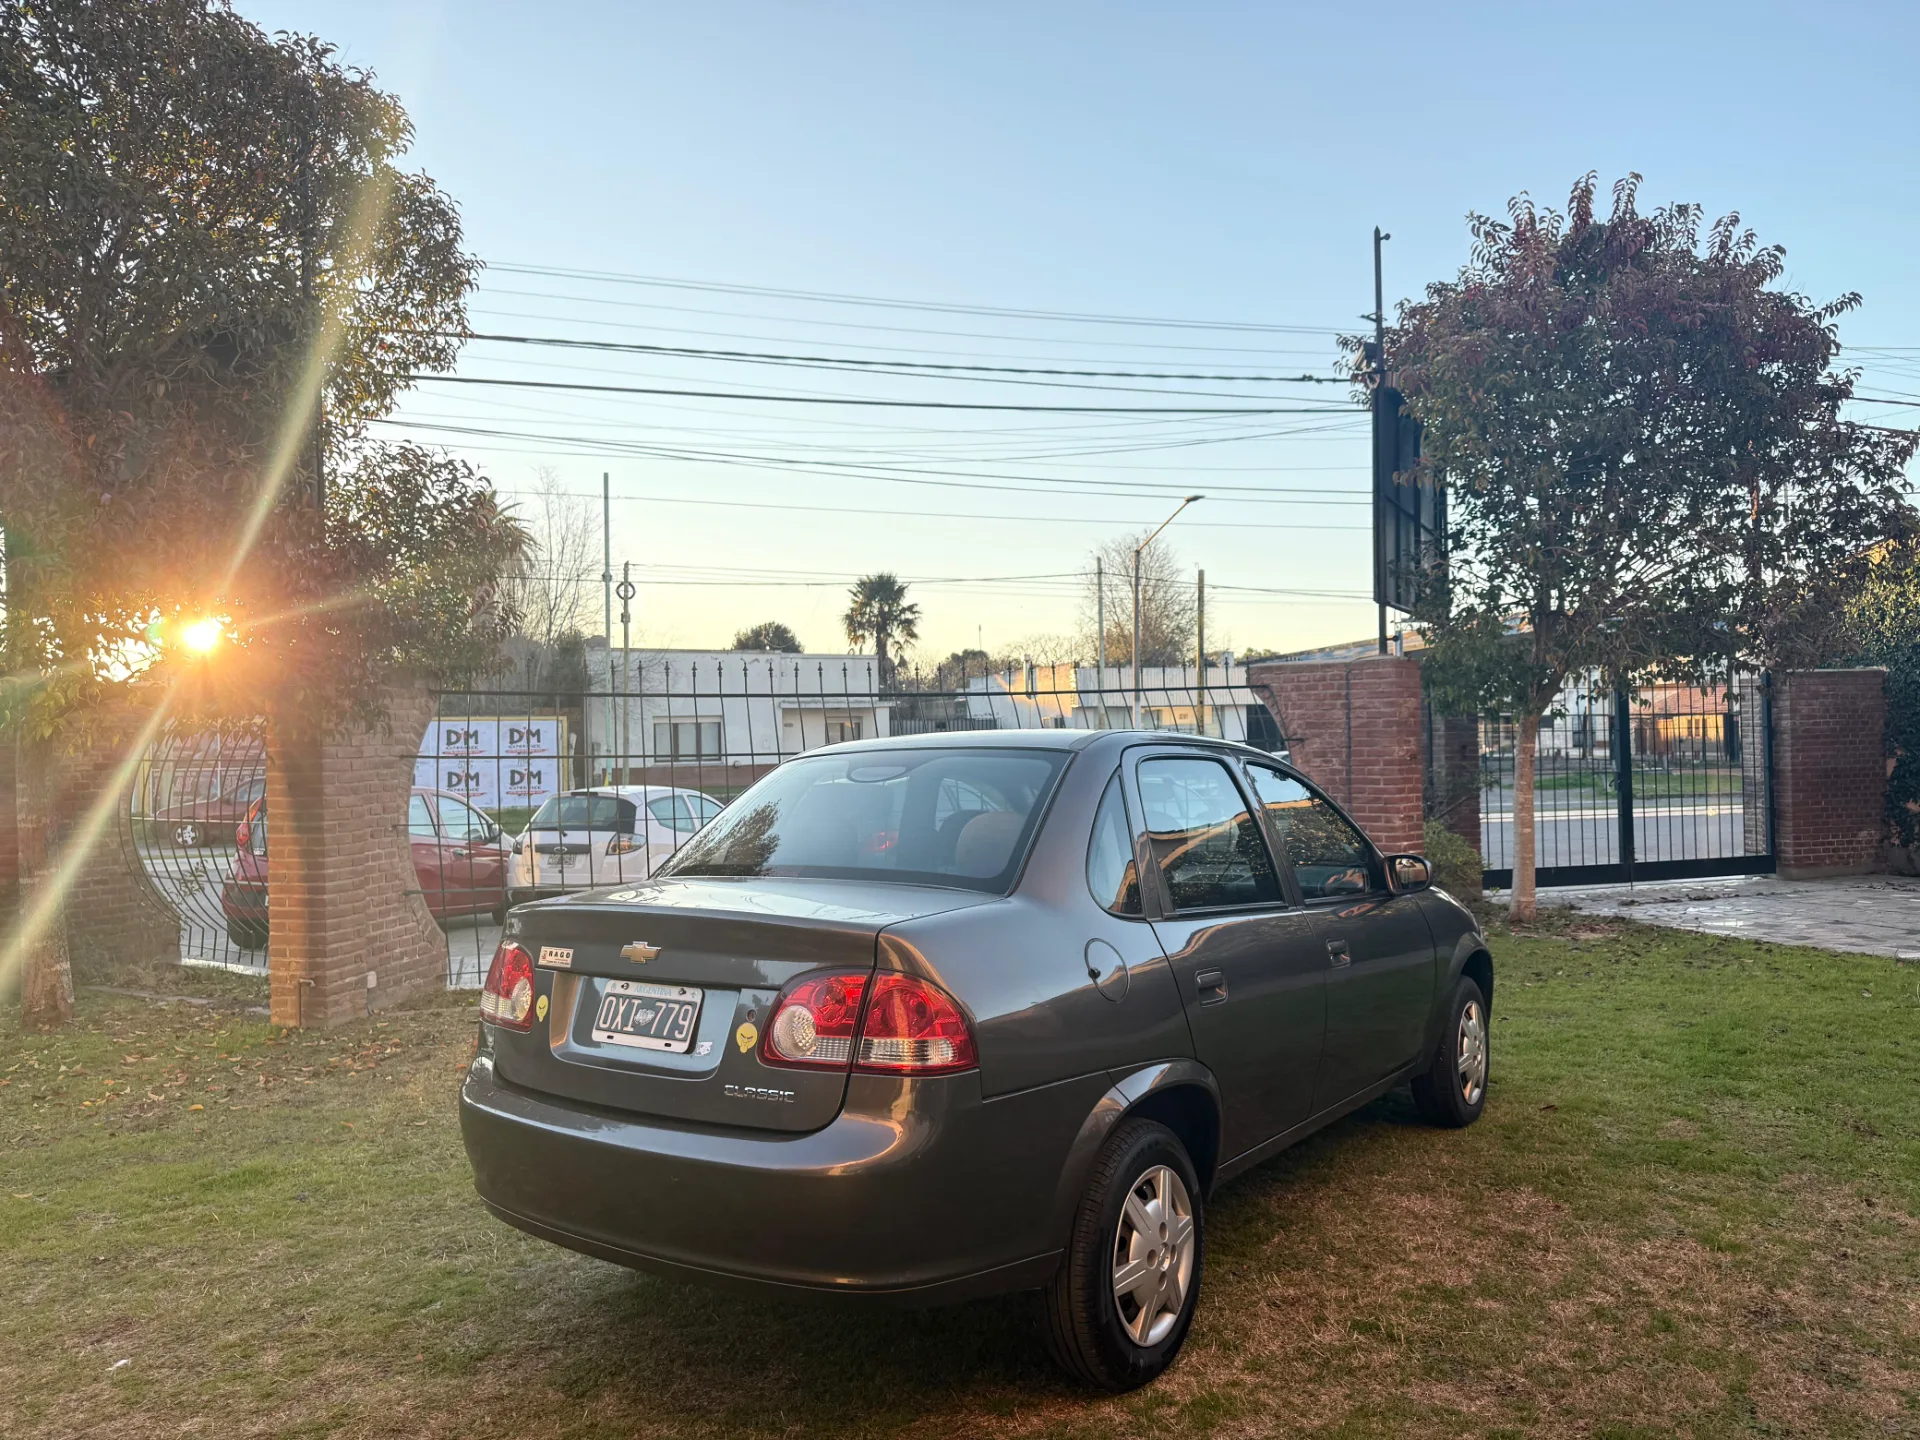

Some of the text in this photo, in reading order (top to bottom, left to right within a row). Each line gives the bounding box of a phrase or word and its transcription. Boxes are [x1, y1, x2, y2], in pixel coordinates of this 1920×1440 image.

[634, 984, 672, 997] ARGENTINA
[599, 996, 693, 1039] OXI 779
[724, 1084, 795, 1103] CLASSIC
